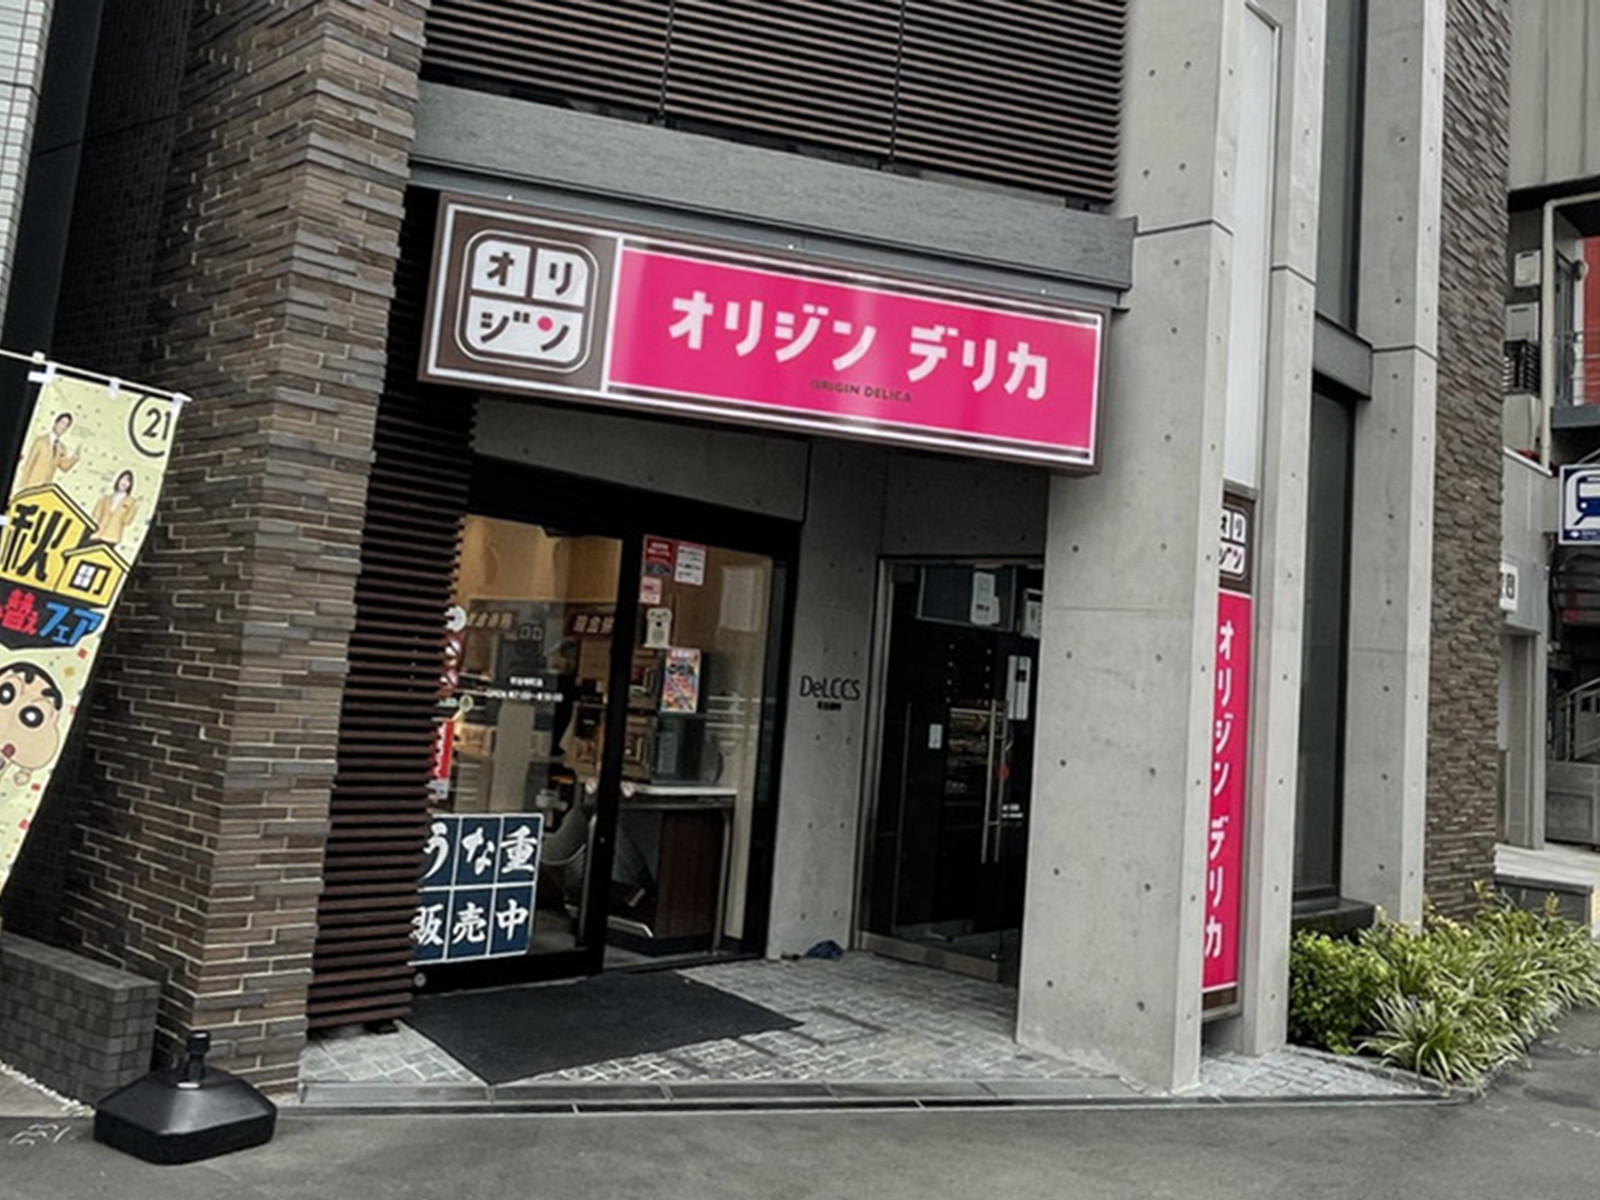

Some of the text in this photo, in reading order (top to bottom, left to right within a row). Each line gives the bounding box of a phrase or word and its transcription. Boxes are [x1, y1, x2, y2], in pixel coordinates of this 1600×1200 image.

[486, 251, 574, 296] オリ
[480, 311, 570, 352] ジン
[669, 291, 1048, 401] オリジン デリカ
[864, 386, 912, 403] DELICA
[142, 407, 171, 441] 21
[1204, 620, 1235, 958] オリジン デリカ
[422, 821, 538, 881] うな重
[408, 898, 529, 946] 販売中
